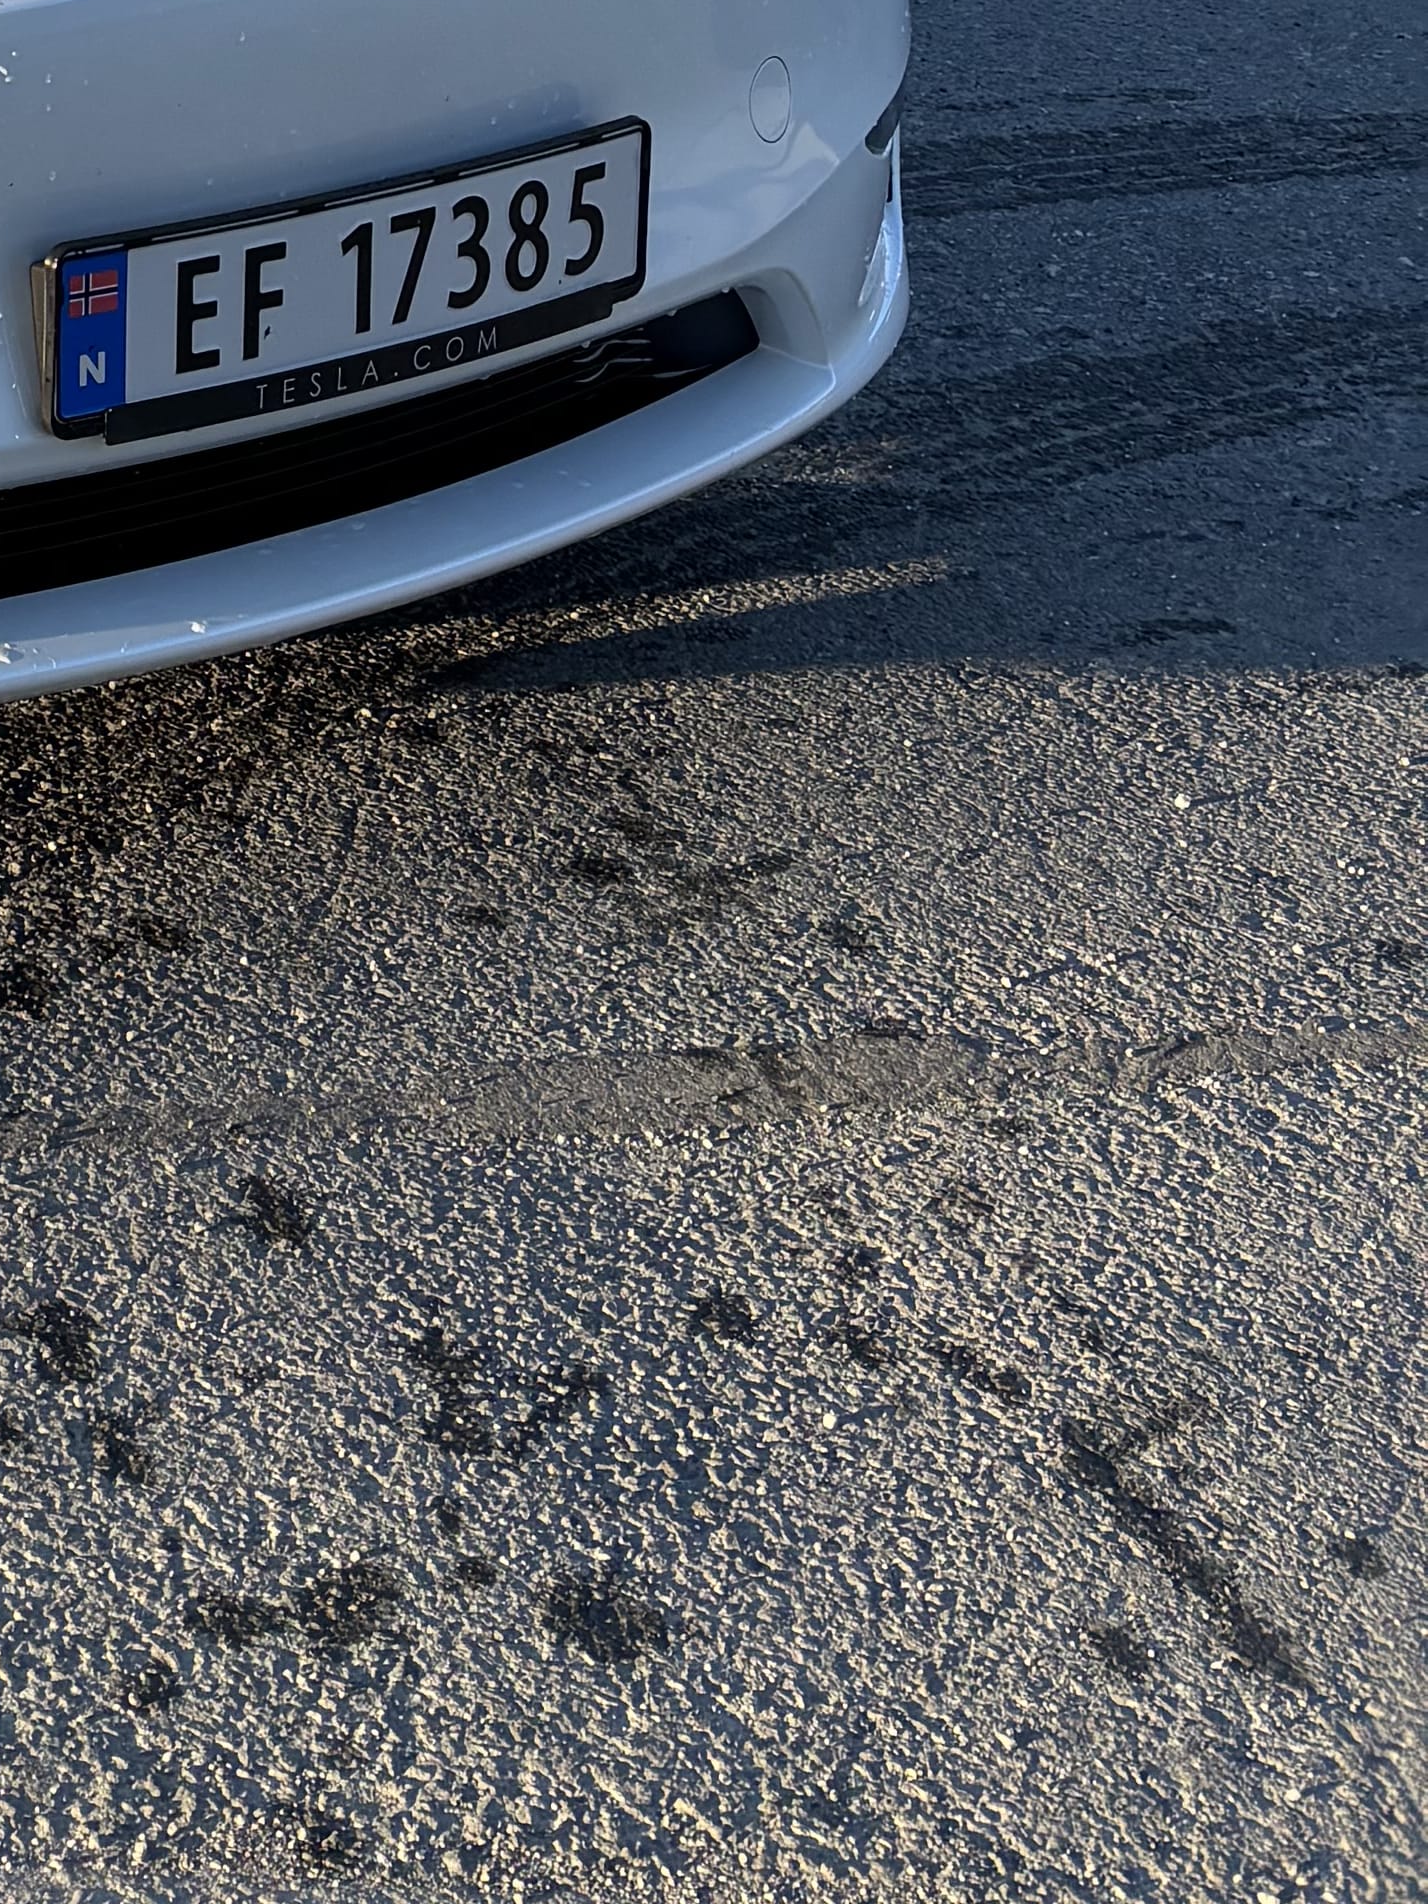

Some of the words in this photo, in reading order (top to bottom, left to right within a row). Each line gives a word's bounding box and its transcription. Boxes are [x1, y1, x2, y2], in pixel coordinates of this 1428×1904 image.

[175, 240, 287, 374] EF
[340, 161, 607, 335] 17385
[77, 351, 107, 388] N
[255, 325, 500, 411] TESLA.COM
